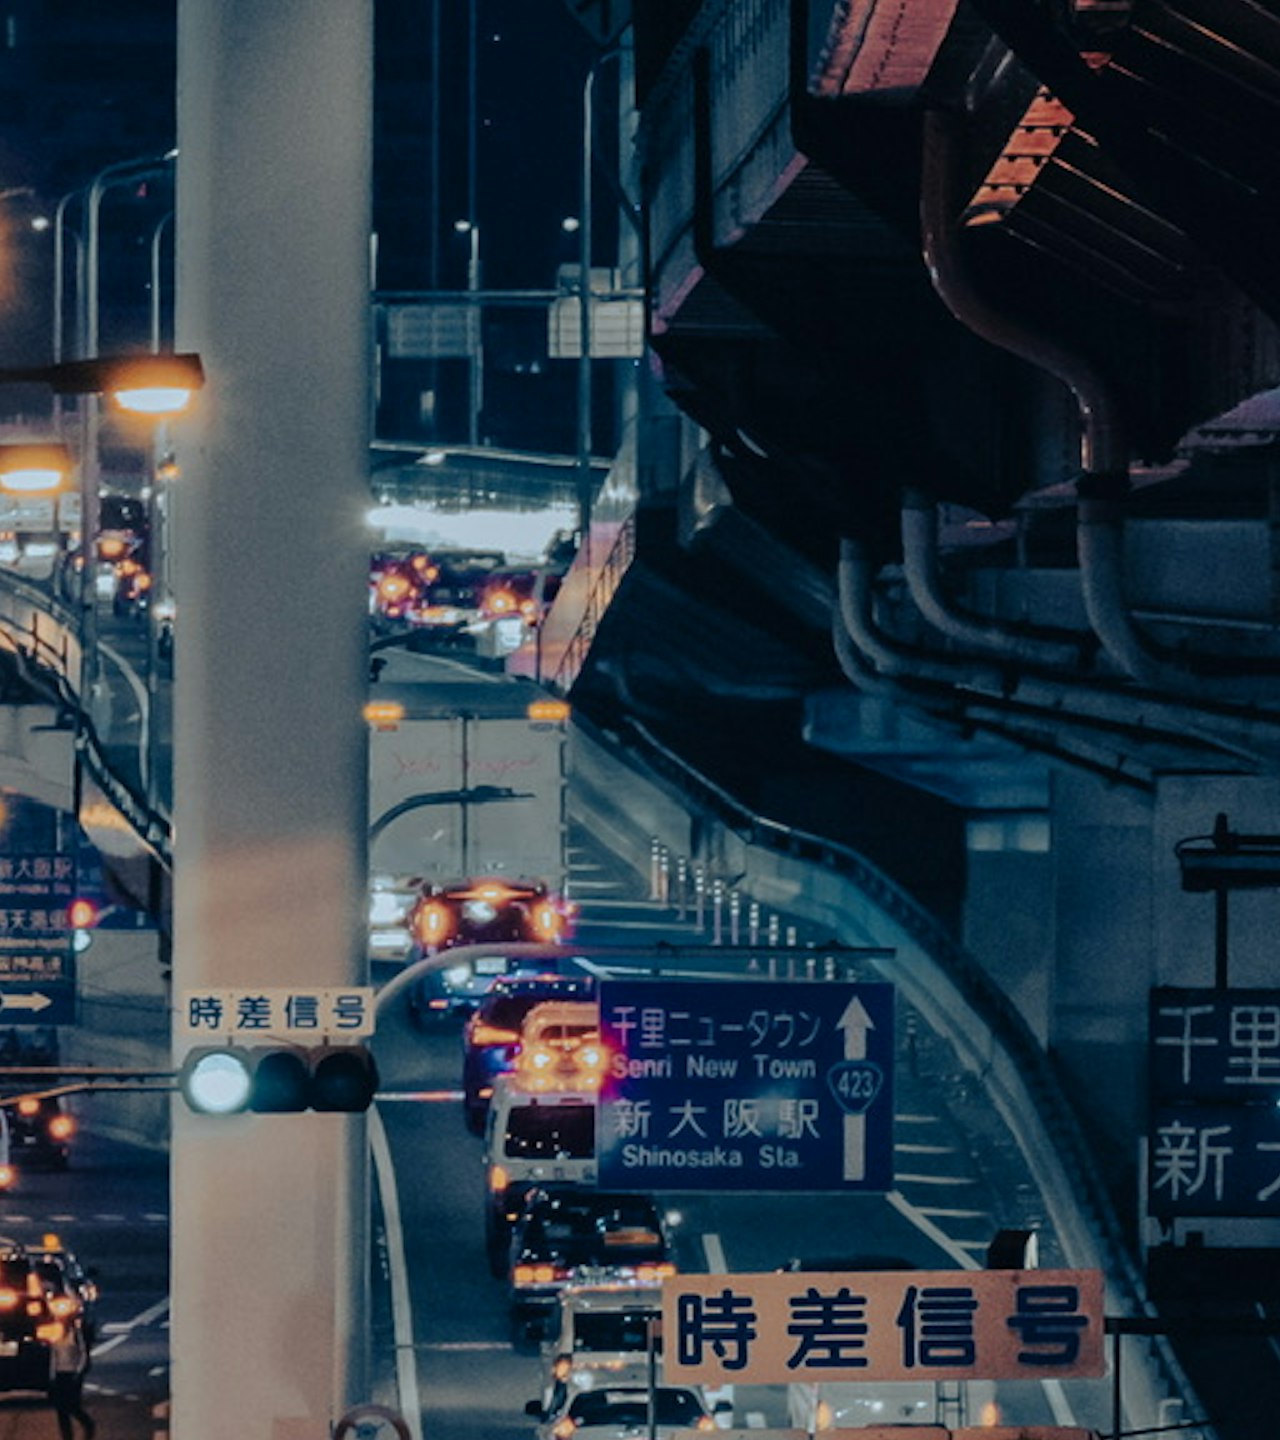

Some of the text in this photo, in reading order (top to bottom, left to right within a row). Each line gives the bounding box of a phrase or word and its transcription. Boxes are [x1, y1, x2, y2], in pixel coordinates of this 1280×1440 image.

[188, 995, 369, 1032] 時差信号
[610, 1005, 822, 1050] 千里ニュータウン
[610, 1053, 816, 1080] Senri New Town
[837, 1070, 875, 1099] 423
[612, 1097, 821, 1140] 新大阪駅
[621, 1143, 744, 1169] Shinosaka
[677, 1285, 1089, 1370] 時差信号
